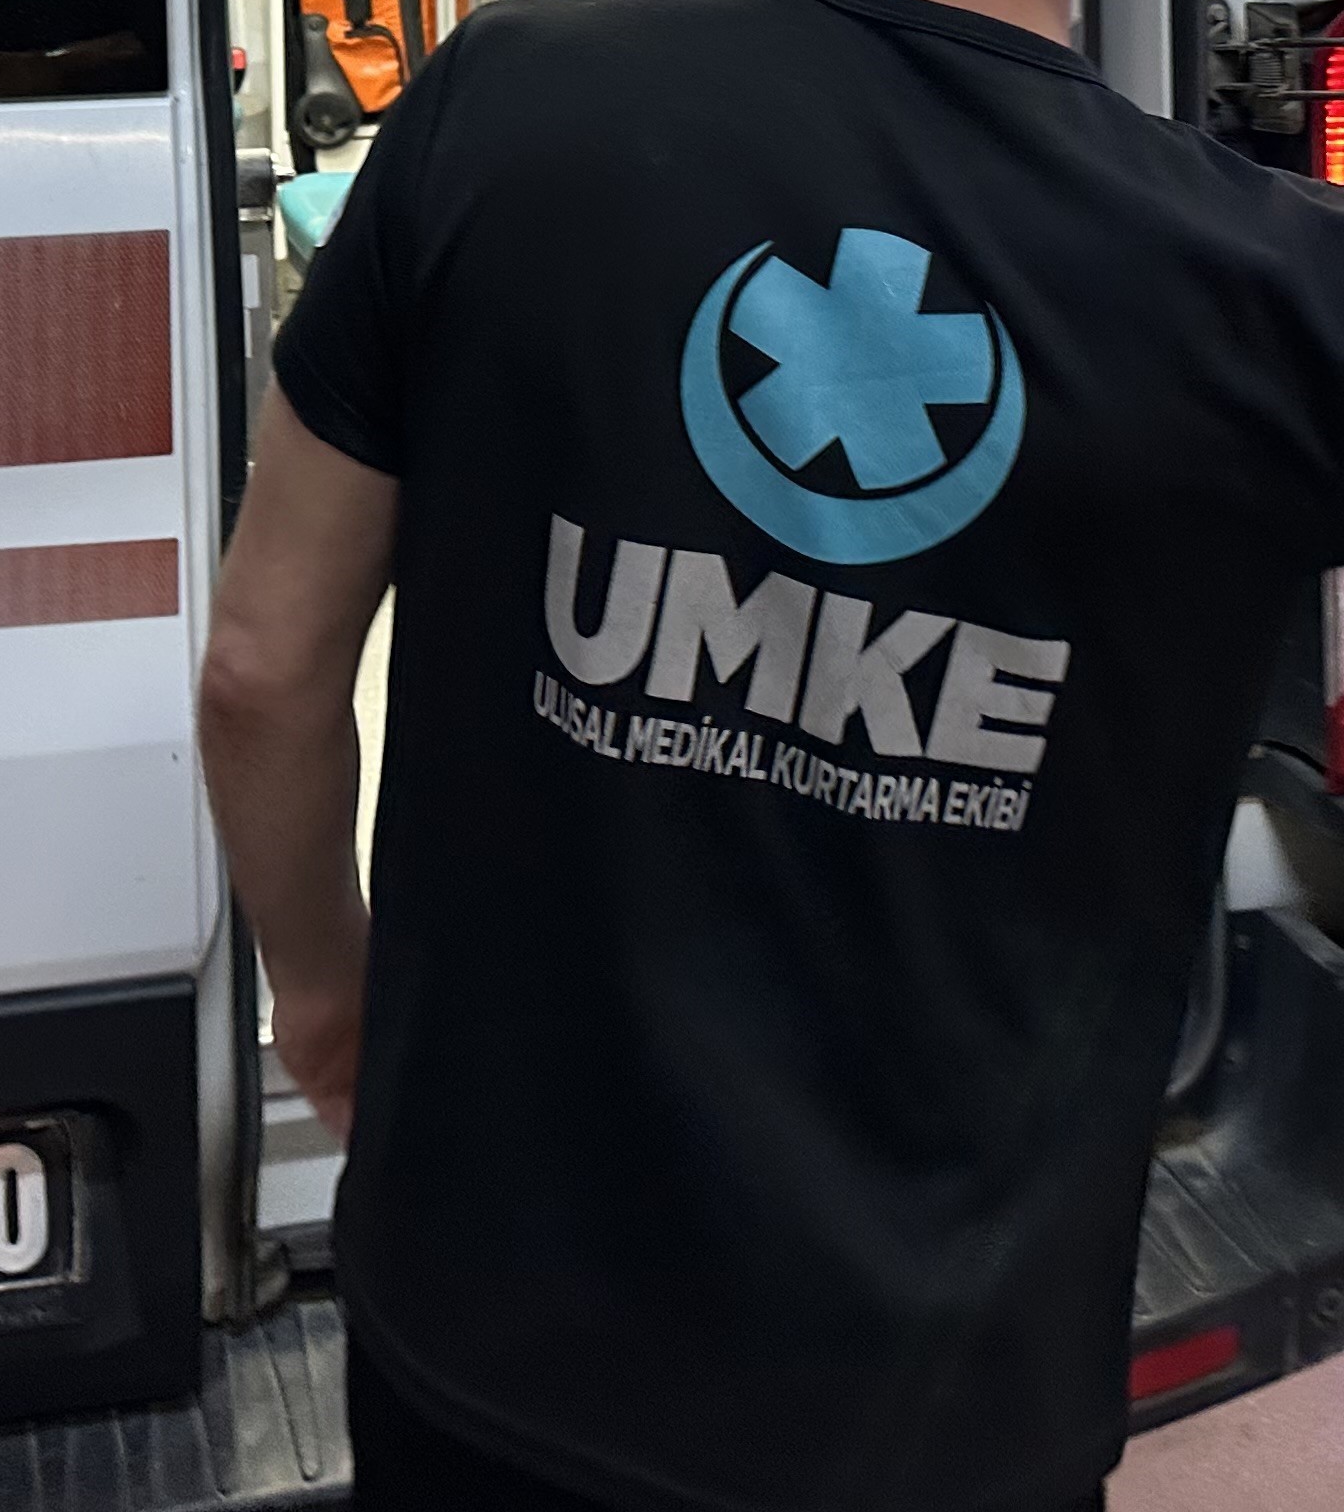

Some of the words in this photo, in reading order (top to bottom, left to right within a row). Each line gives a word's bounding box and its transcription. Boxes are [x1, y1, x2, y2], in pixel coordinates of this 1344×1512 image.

[544, 513, 1072, 774] UMKE
[533, 670, 622, 761] ULUSAL
[623, 714, 769, 782] MEDİKAL
[770, 740, 941, 823] KURTARMA
[942, 775, 1033, 832] EKİBİ
